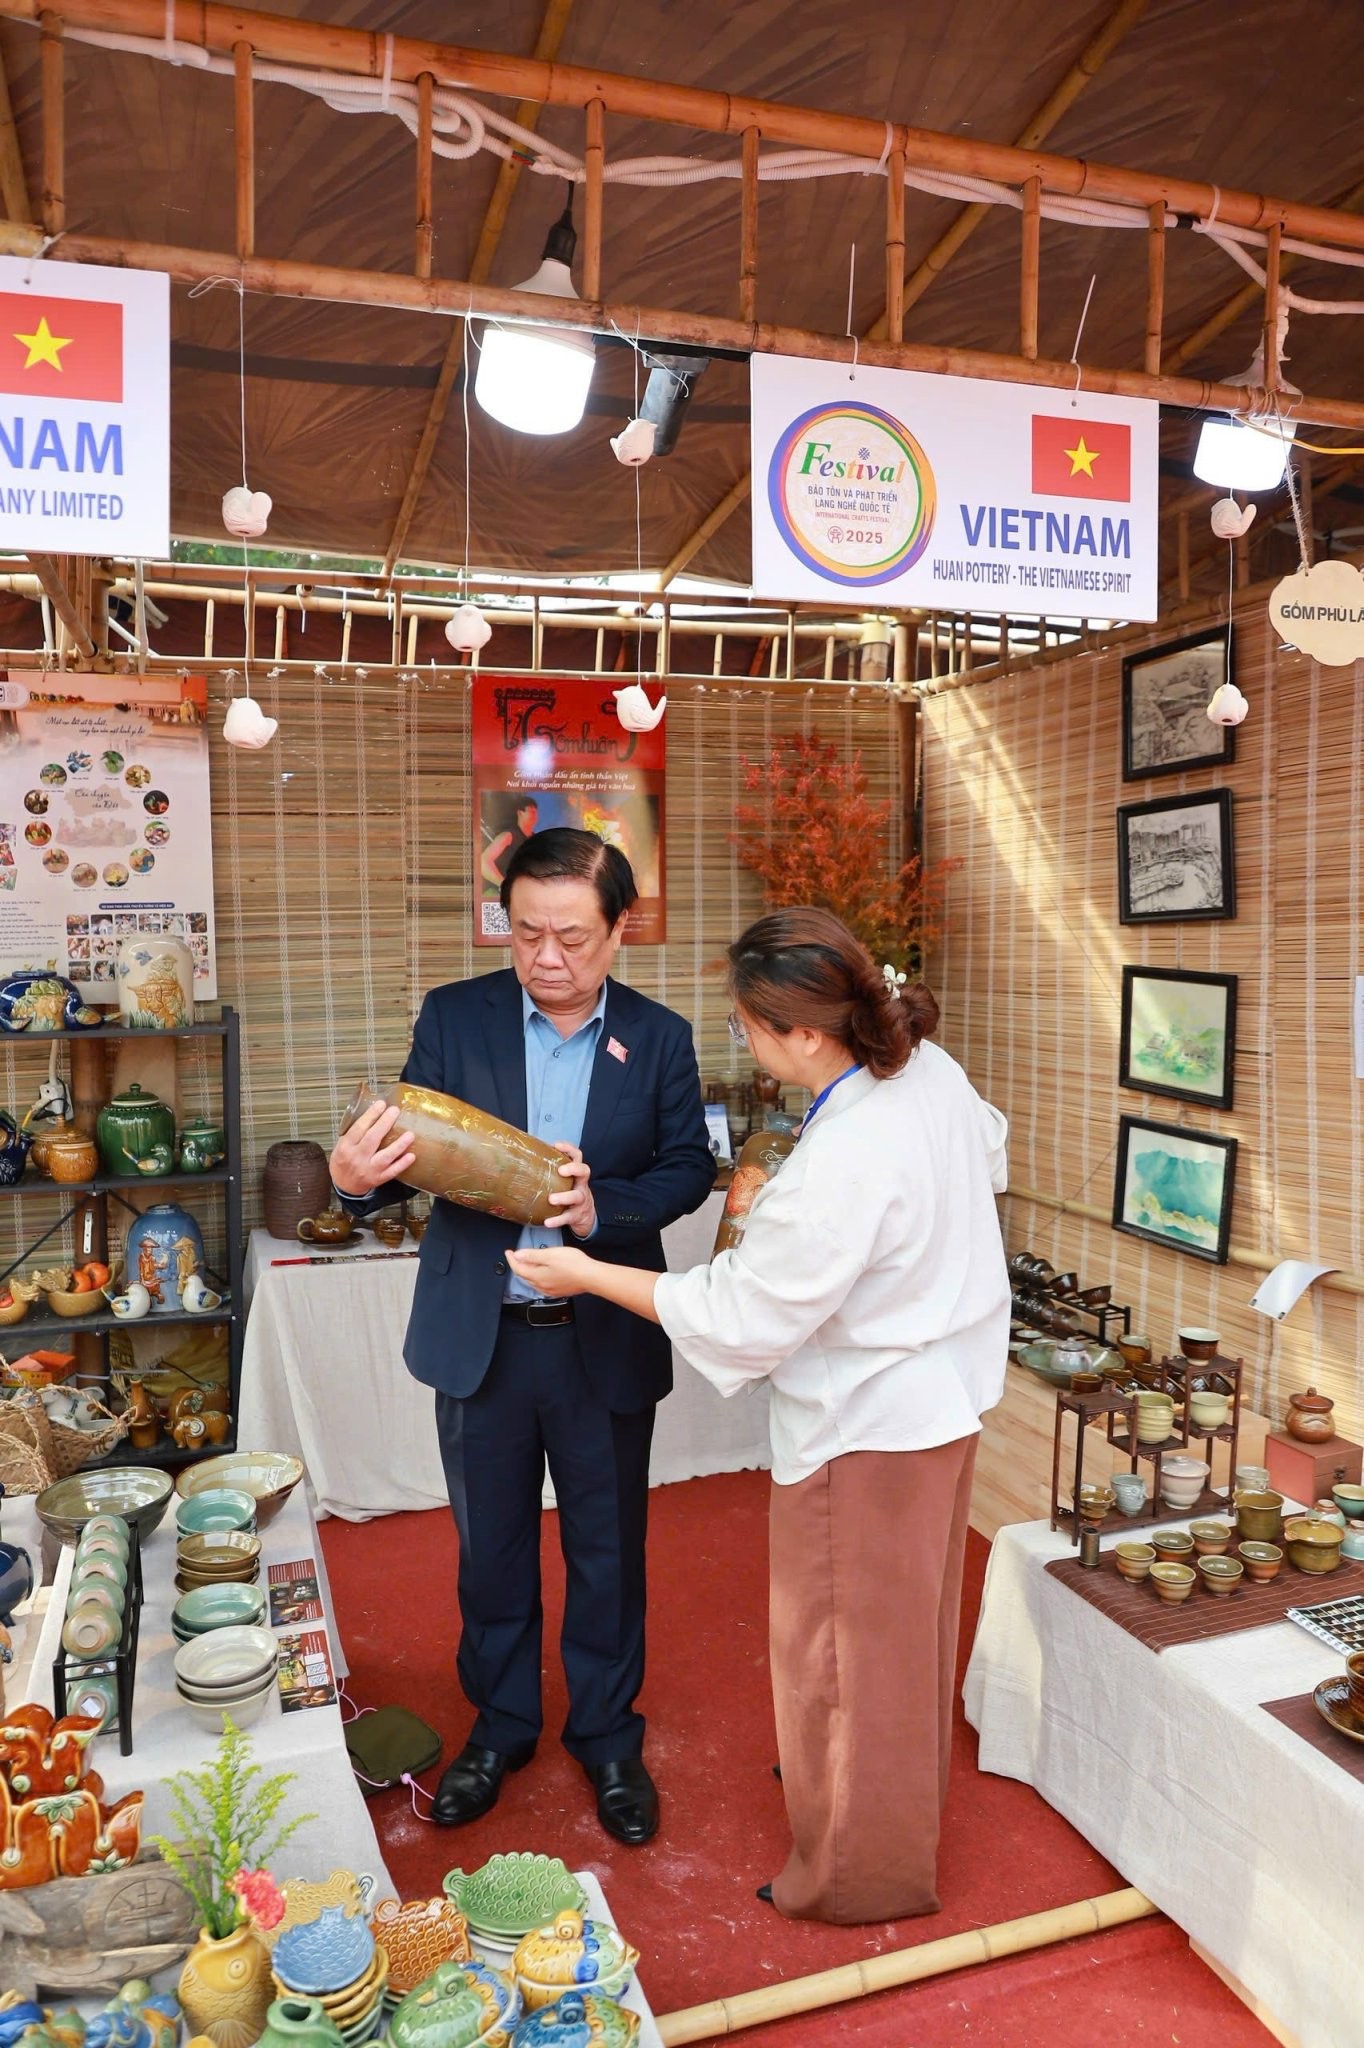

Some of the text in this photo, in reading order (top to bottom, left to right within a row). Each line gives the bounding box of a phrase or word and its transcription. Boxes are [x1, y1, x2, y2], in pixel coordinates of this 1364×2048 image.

[797, 441, 906, 484] Festival
[41, 490, 124, 520] LIMITED
[846, 529, 883, 544] 2025
[959, 504, 1131, 559] VIETNAM
[933, 559, 964, 582] HUAN
[965, 561, 1011, 585] POTTERY
[1018, 565, 1038, 587] THE
[1039, 567, 1100, 591] VIETNAMESE
[1102, 572, 1131, 593] SPIRIT
